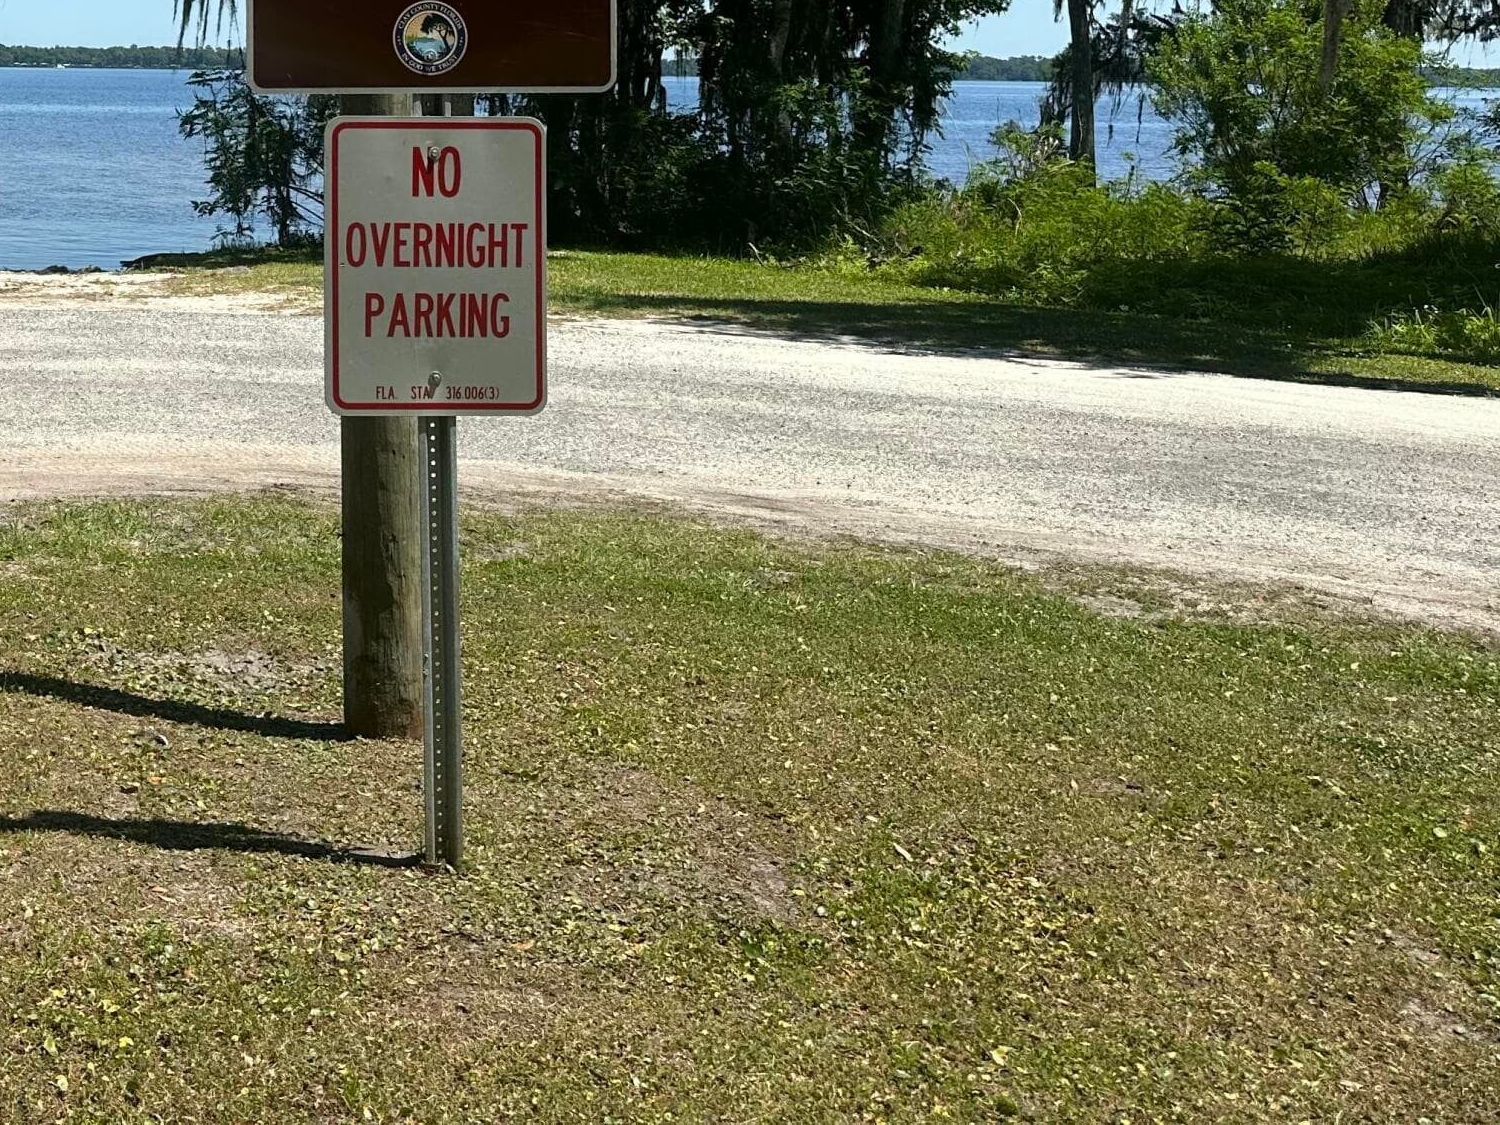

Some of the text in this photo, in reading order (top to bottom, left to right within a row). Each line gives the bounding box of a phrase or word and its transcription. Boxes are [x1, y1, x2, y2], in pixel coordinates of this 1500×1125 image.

[398, 13, 411, 29] CLAY
[411, 4, 439, 14] COUNTY
[408, 60, 424, 71] GOD
[411, 146, 461, 198] NO
[345, 222, 528, 268] OVERNIGHT
[364, 293, 510, 338] PARKING
